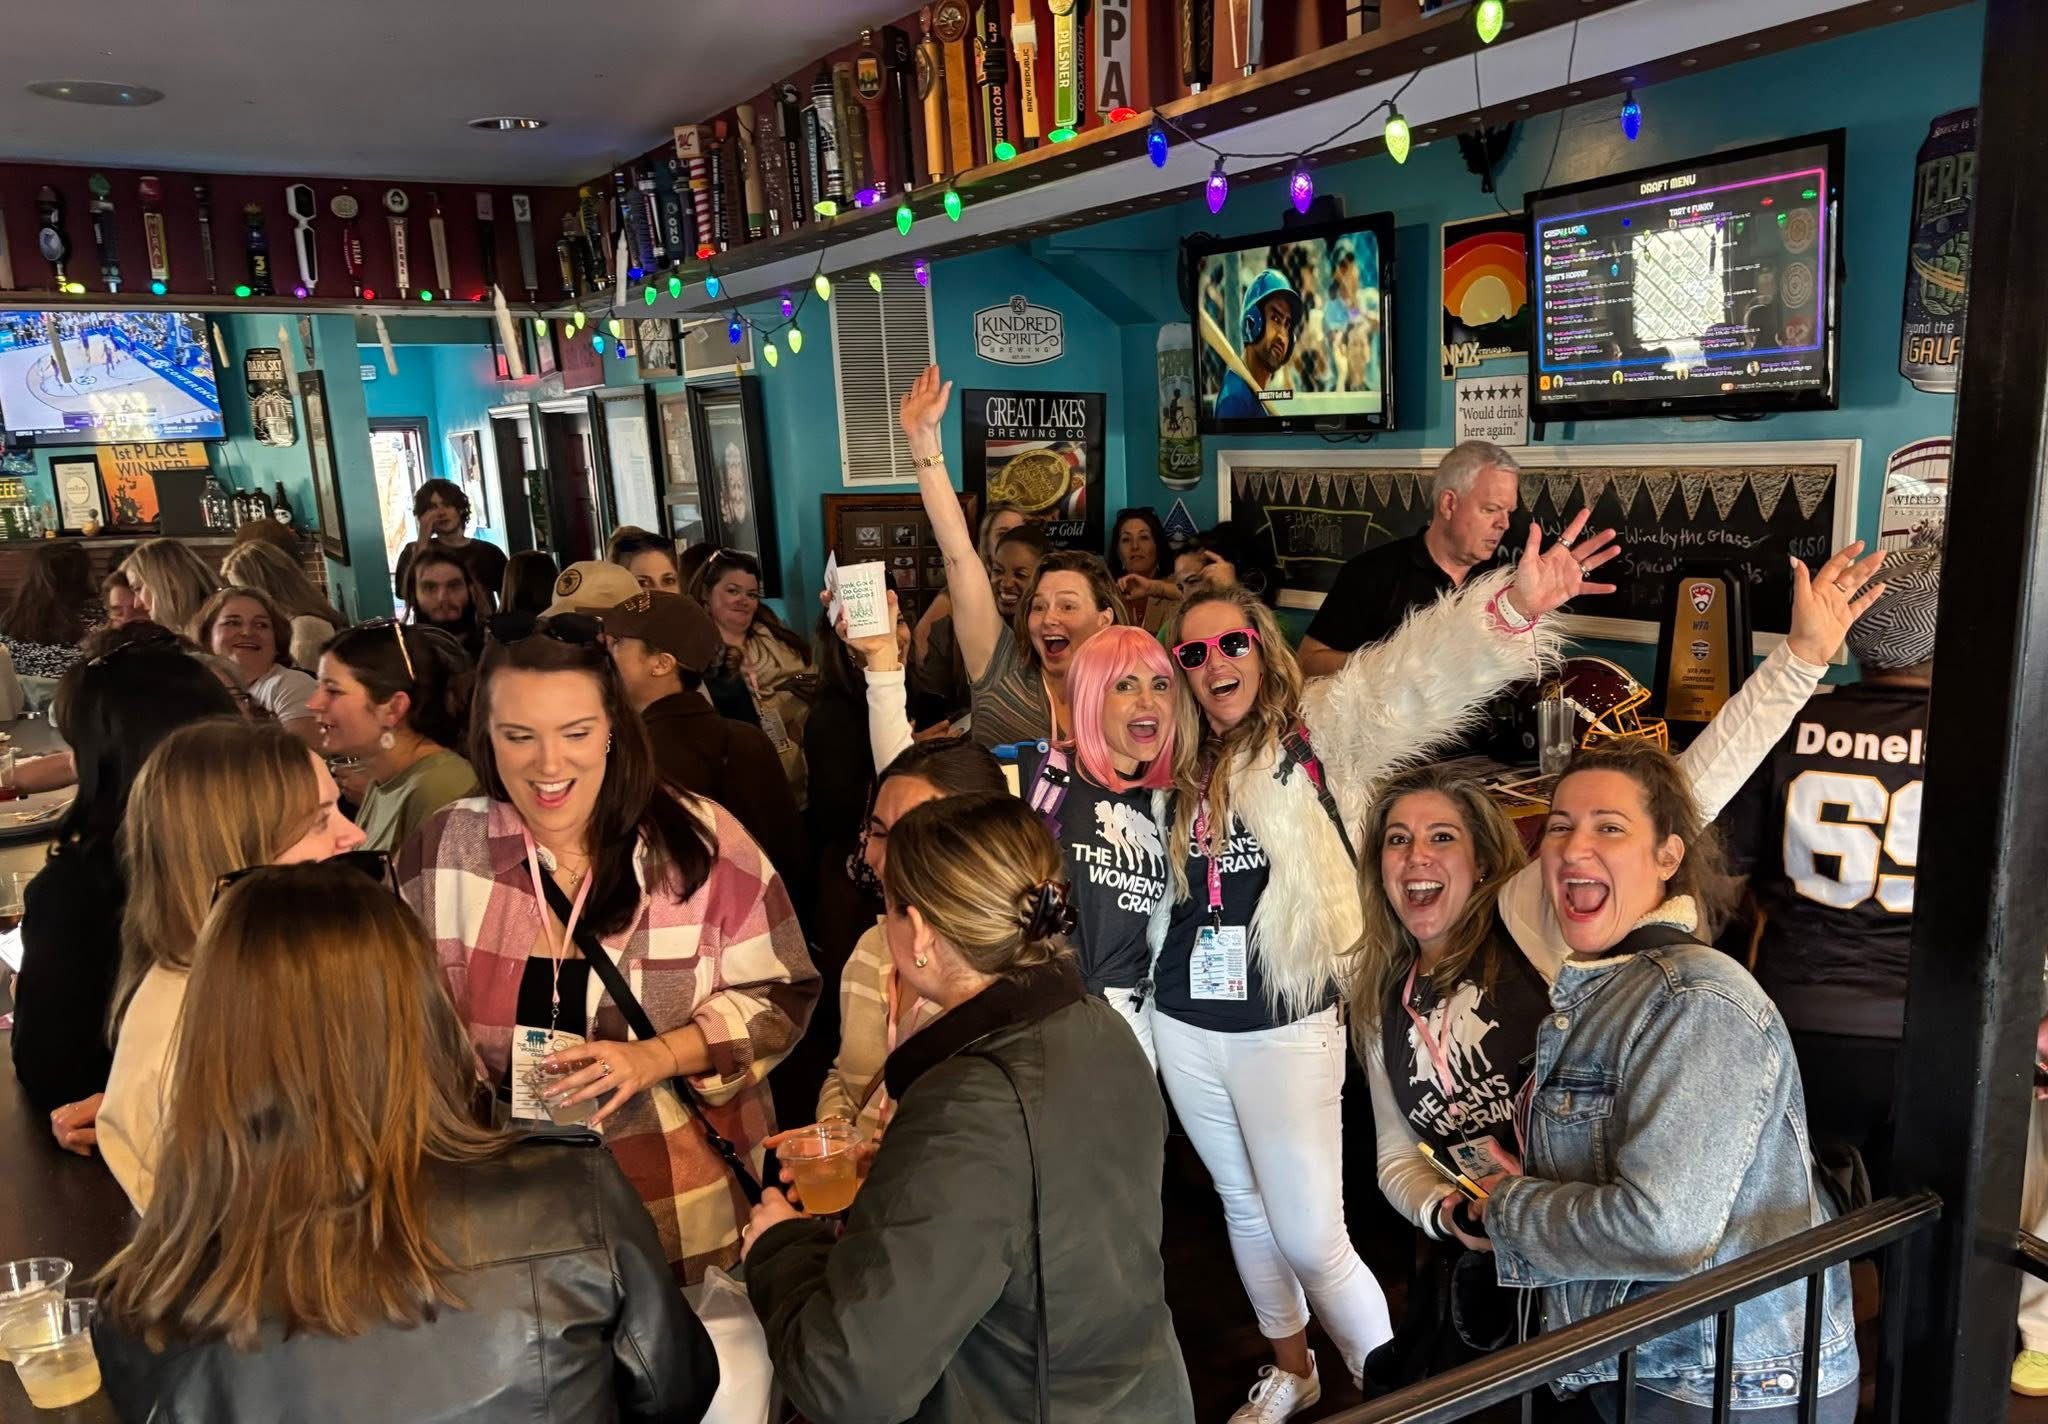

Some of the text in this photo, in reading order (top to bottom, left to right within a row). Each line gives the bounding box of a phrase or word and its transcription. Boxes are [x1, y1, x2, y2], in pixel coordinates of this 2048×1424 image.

[1057, 30, 1070, 88] PILSNER
[1100, 0, 1128, 108] PA
[1023, 48, 1032, 87] REPUBLIC
[789, 141, 803, 220] DESCHUTES
[1640, 173, 1697, 195] DRAFT MENU
[982, 316, 1057, 336] KINDRED
[1934, 320, 1954, 334] the
[989, 346, 1050, 354] BREWING
[993, 333, 1048, 346] SPIRIT
[246, 359, 283, 371] DARK SKY
[986, 396, 1086, 428] GREAT LAKES
[1496, 404, 1524, 419] drink
[987, 428, 1057, 439] BREWING
[1464, 424, 1485, 438] here
[112, 442, 188, 461] 1st PLACE
[1893, 495, 1941, 506] WICKED
[1058, 521, 1084, 537] Gold
[1659, 527, 1678, 550] by
[1679, 527, 1705, 547] the
[1707, 529, 1753, 549] Glass
[1795, 722, 1926, 765] Donel
[1072, 843, 1112, 867] THE
[1189, 837, 1262, 858] OEN'S
[1089, 865, 1165, 899] WOMEN'S
[1409, 1091, 1444, 1129] THE
[1433, 1074, 1511, 1137] WEN'S
